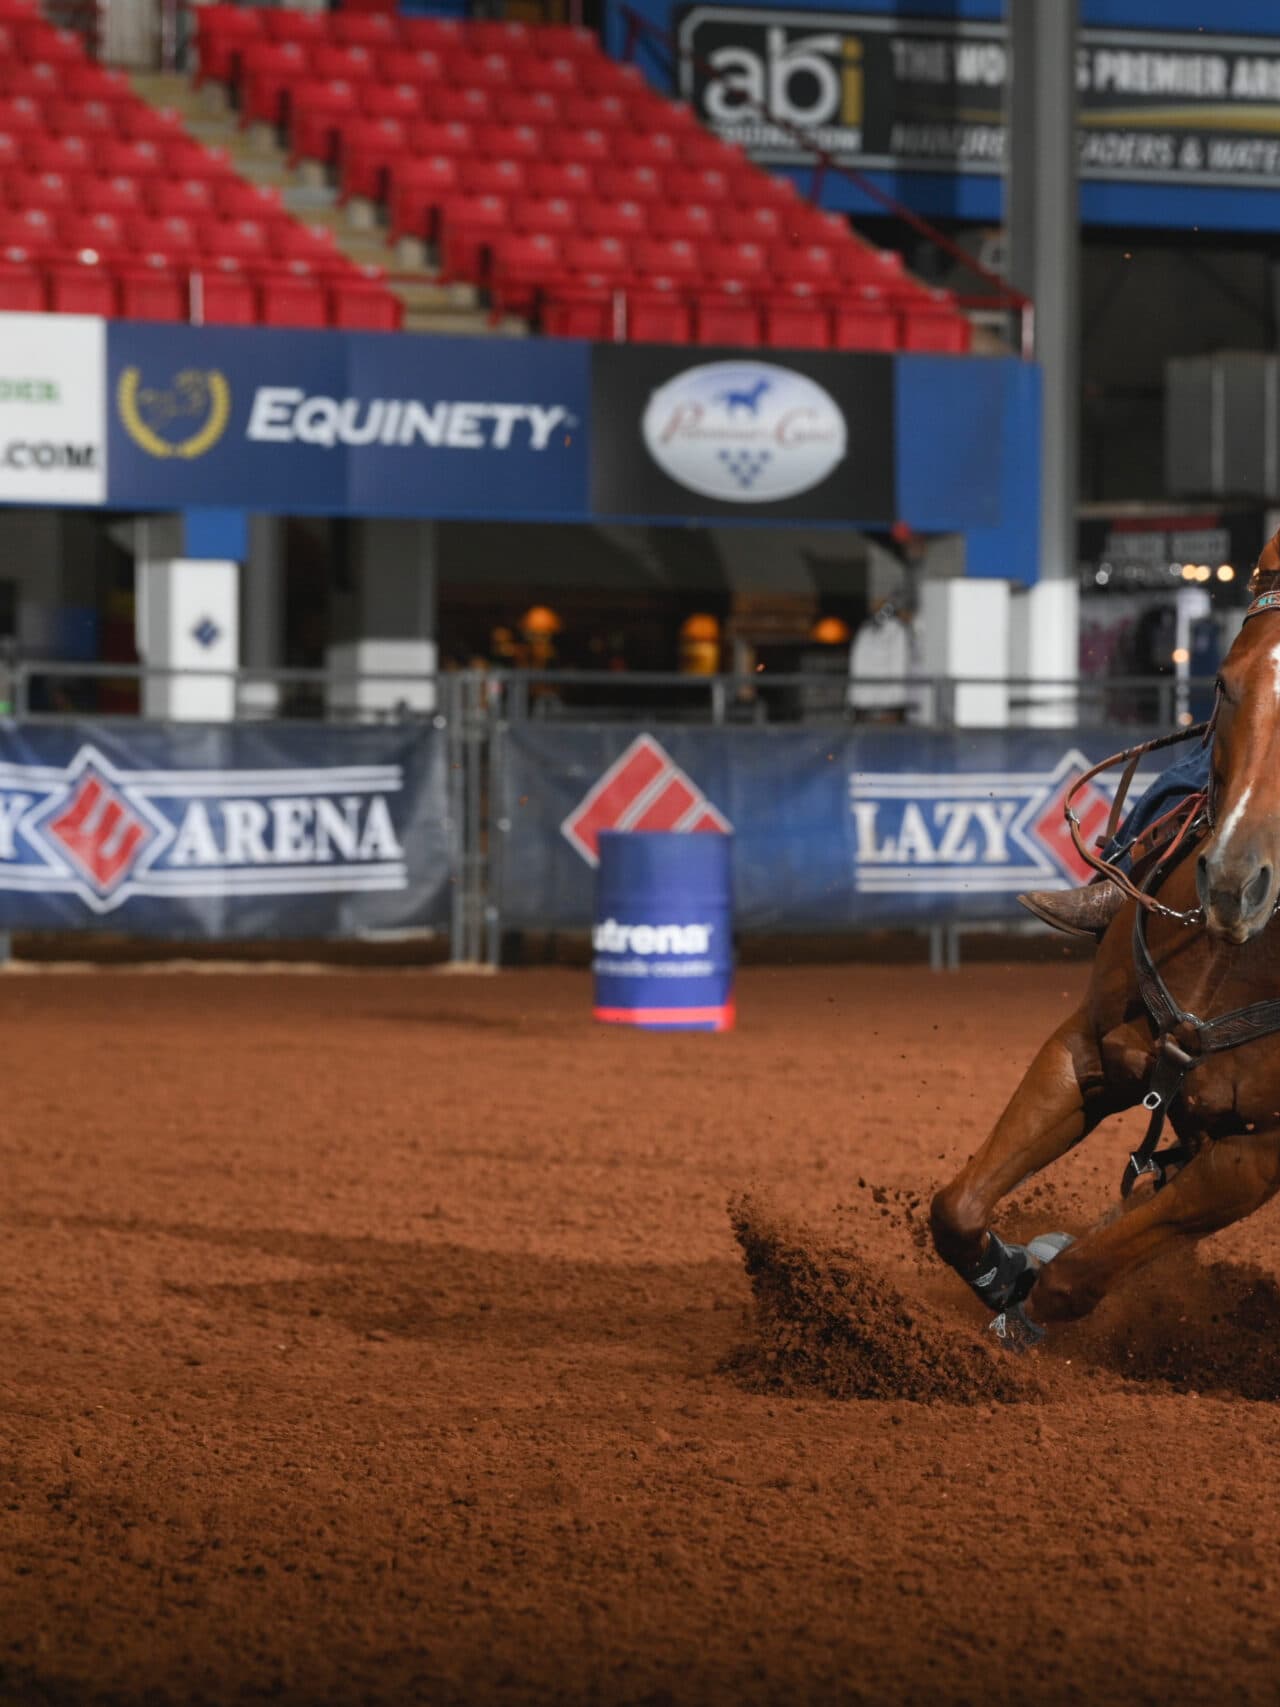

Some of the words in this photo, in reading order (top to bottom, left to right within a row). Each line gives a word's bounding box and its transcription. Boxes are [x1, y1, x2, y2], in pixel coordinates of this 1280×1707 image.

[705, 26, 863, 127] abi
[1094, 50, 1227, 96] PREMIER
[1178, 136, 1200, 168] &
[171, 797, 404, 864] ARENA
[853, 800, 1015, 863] LAZY
